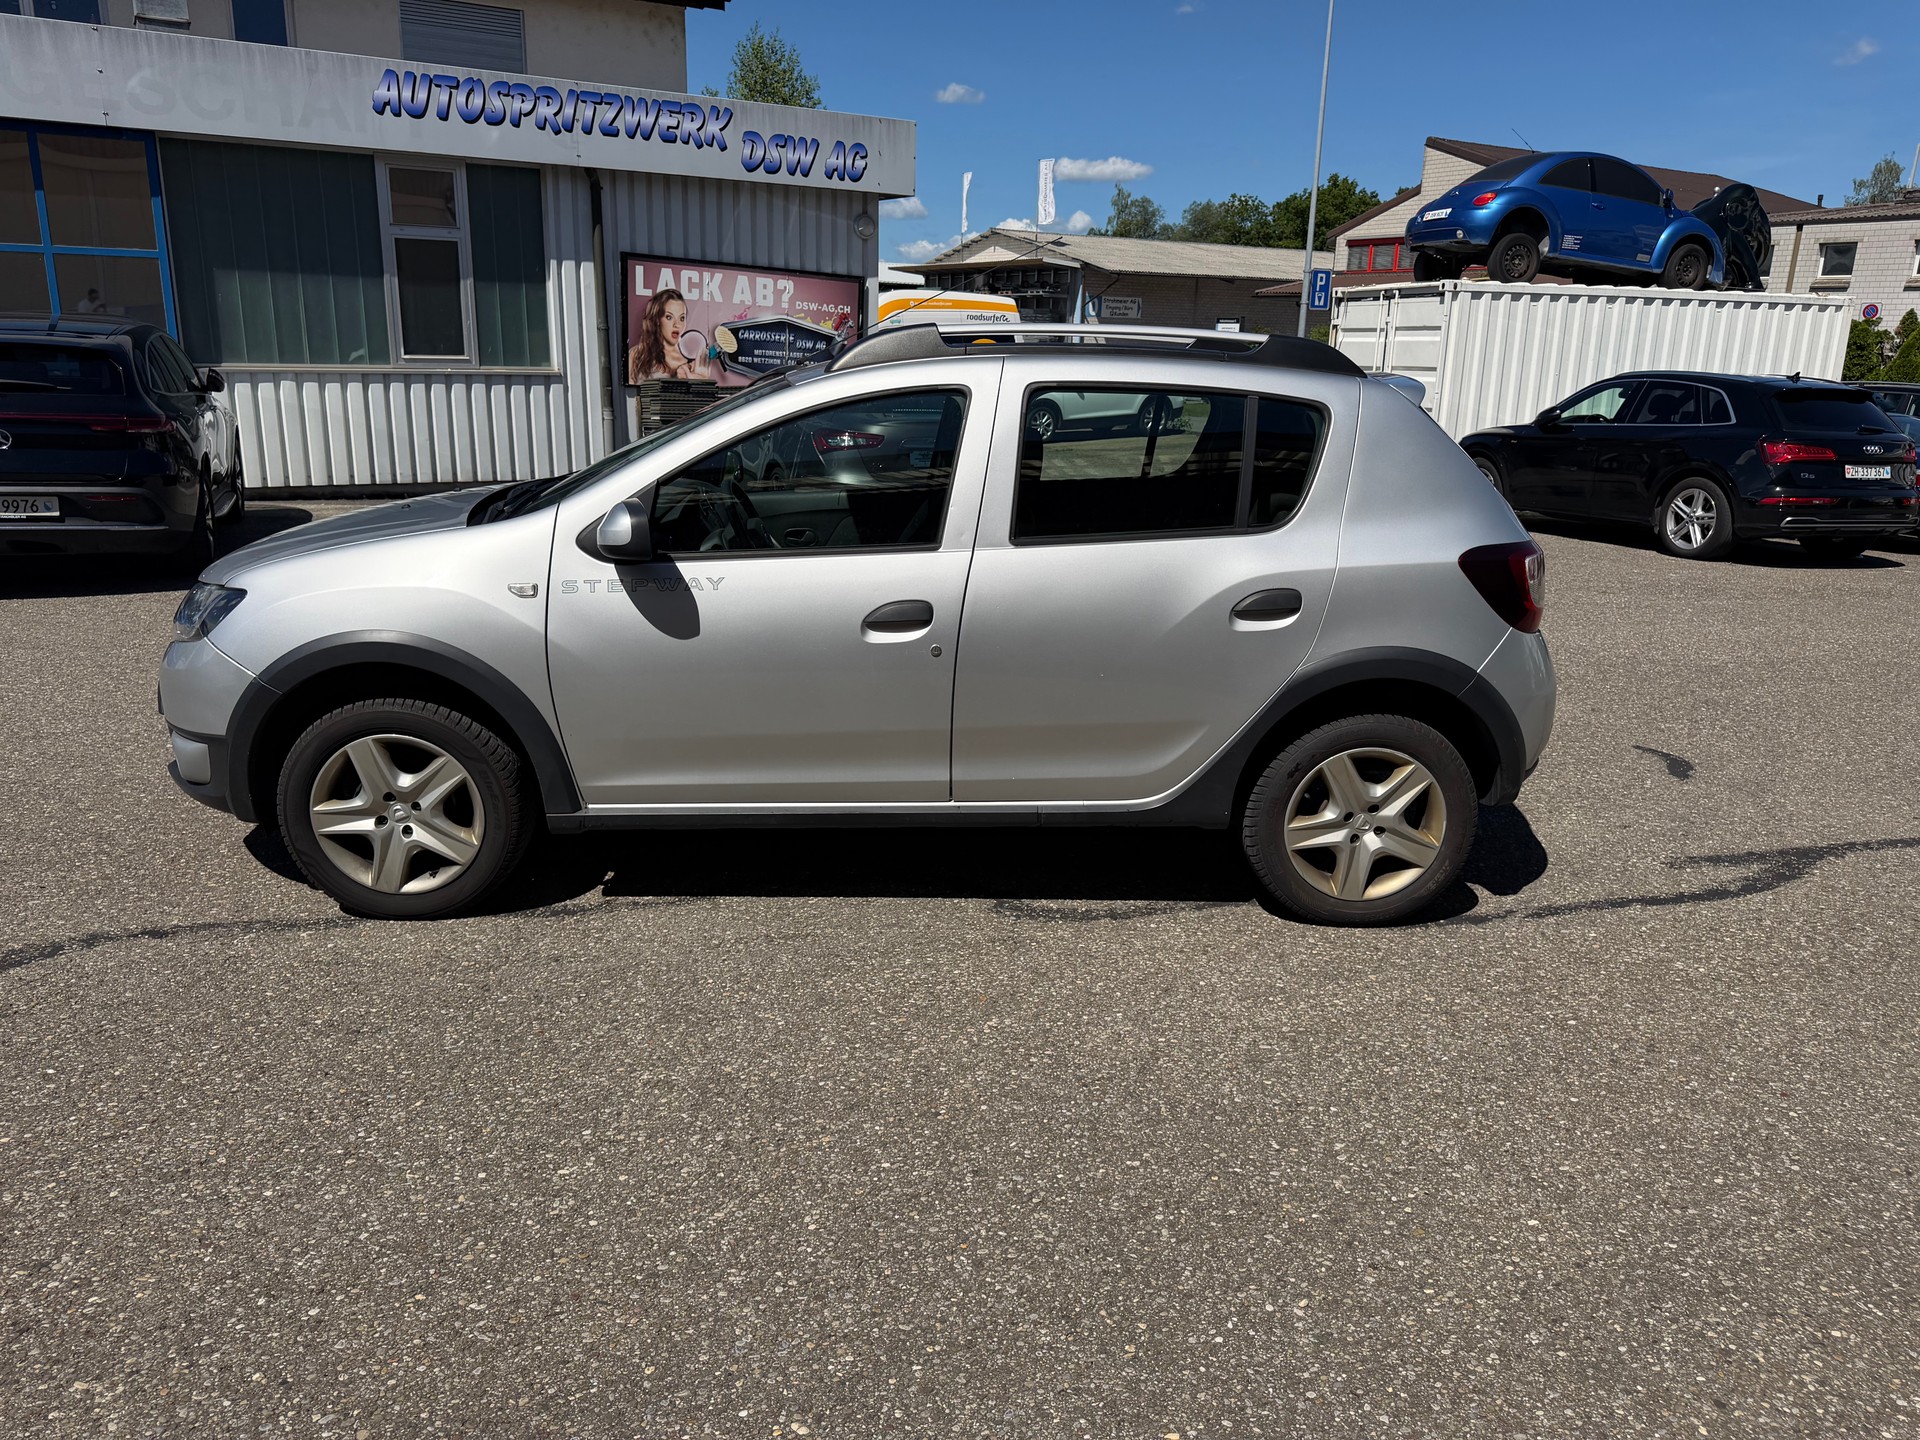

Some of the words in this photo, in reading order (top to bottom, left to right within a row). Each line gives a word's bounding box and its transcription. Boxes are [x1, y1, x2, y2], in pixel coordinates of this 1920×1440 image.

[372, 68, 734, 151] AUTOSPRITZWERK
[740, 131, 820, 177] DSW
[823, 140, 868, 183] AG
[635, 265, 723, 304] LACK
[732, 275, 794, 309] AB?
[1316, 273, 1326, 291] P
[796, 340, 814, 349] DSW
[561, 577, 726, 594] STEPWAY
